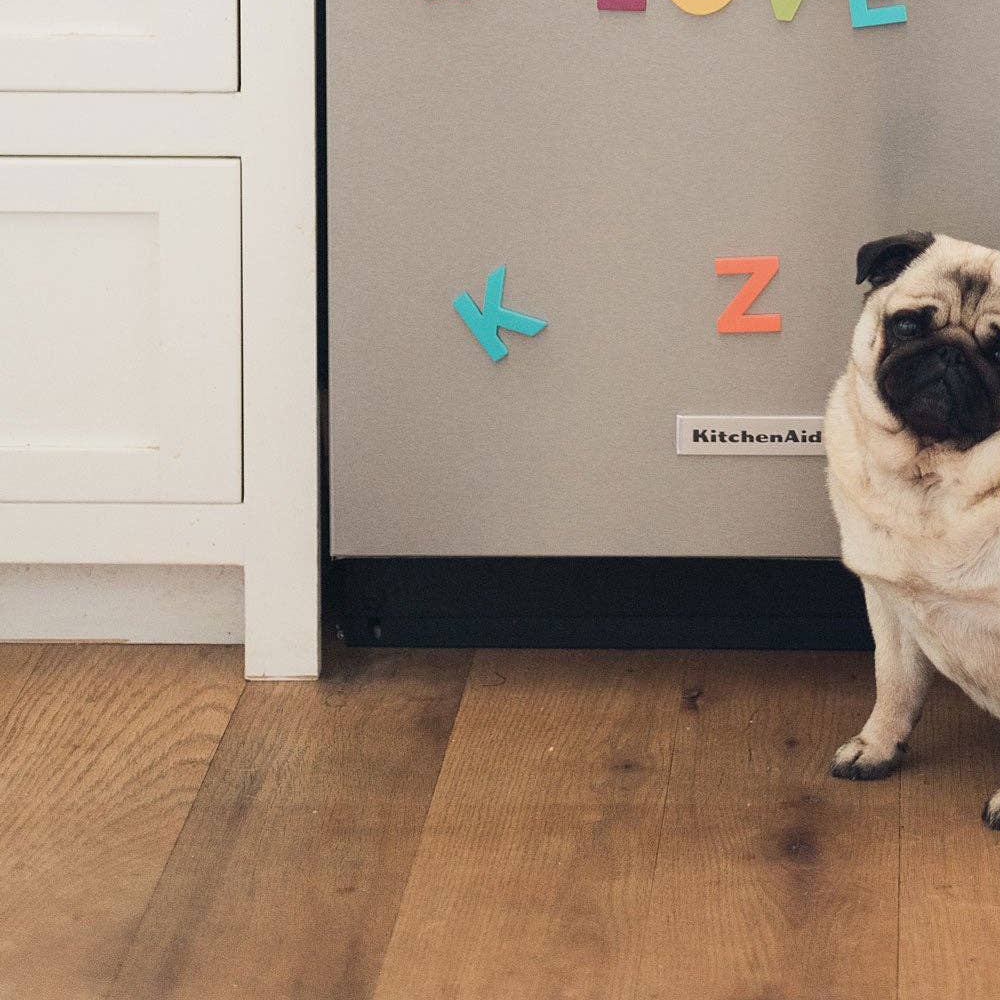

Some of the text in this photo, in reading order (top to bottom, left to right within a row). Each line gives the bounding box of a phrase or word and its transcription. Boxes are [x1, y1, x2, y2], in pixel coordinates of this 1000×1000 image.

[452, 265, 547, 362] K
[713, 254, 783, 336] Z
[692, 429, 822, 443] KitchenAid
